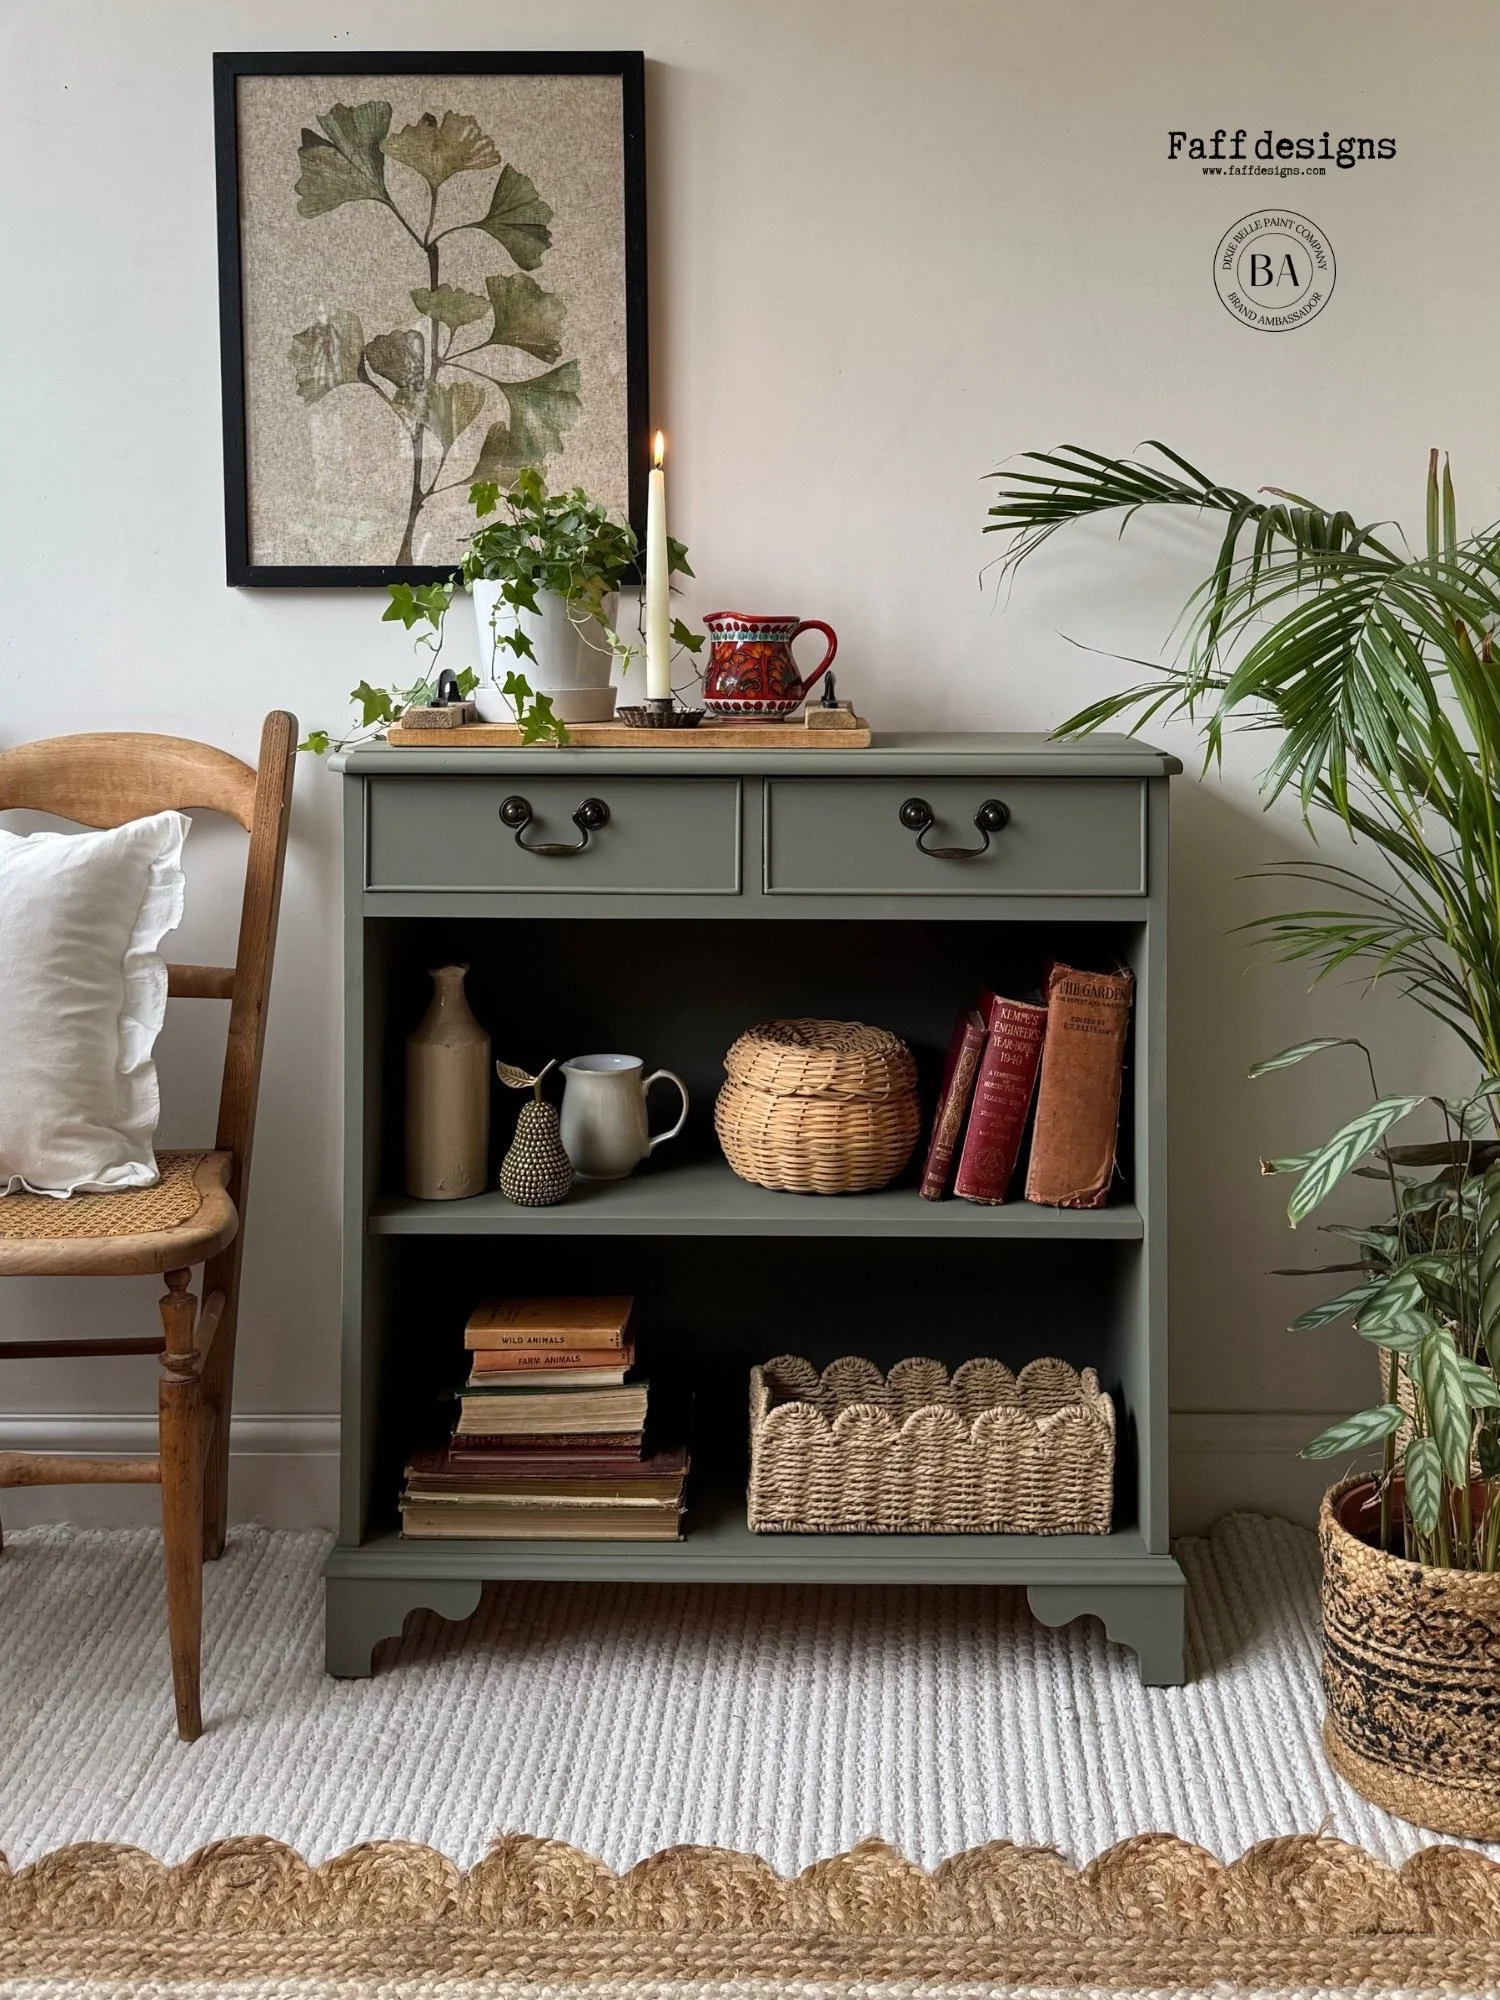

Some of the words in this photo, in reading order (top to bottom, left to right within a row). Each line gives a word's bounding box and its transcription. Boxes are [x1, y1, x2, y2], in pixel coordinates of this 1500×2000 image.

[1059, 981, 1080, 996] THE
[1083, 984, 1127, 1001] GARDEN
[501, 1336, 523, 1344] WILD
[527, 1336, 565, 1344] ANIMALS
[518, 1357, 541, 1365] FARM
[544, 1355, 581, 1364] ANIMALS
